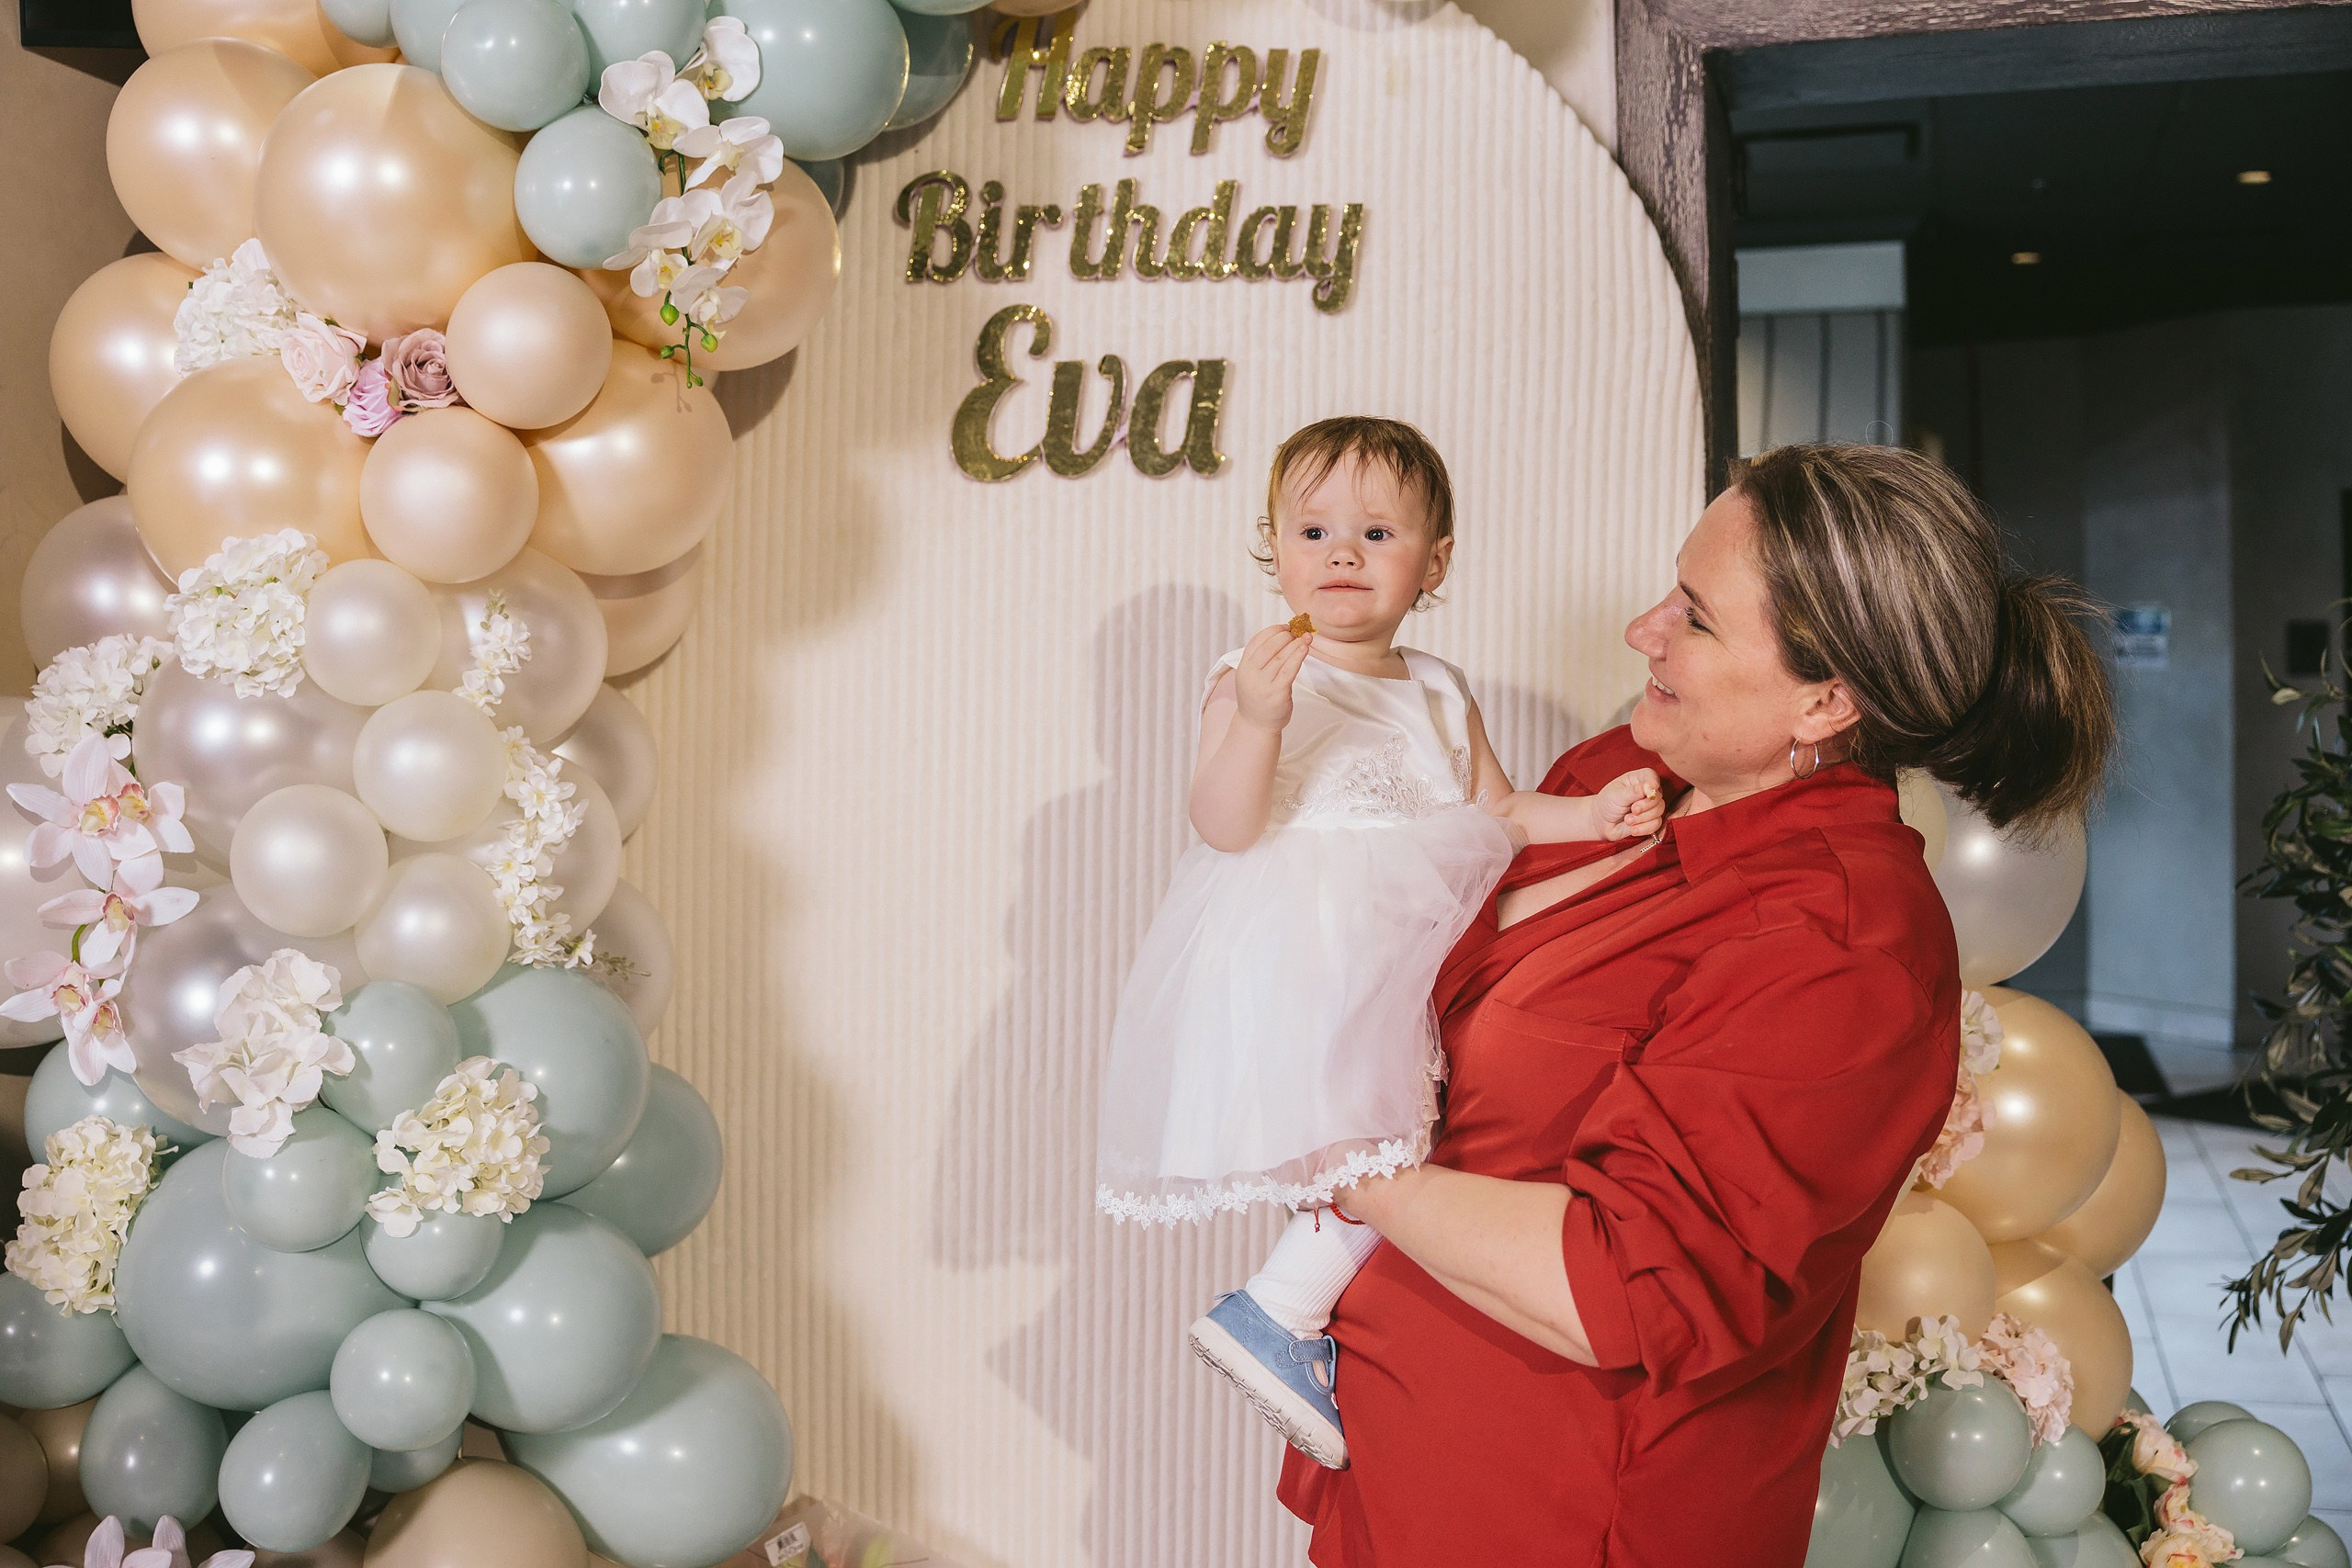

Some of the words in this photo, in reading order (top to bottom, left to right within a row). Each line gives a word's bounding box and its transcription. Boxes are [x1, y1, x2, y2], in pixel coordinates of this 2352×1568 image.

[989, 10, 1320, 157] Happy
[895, 170, 1363, 313] Birthday
[951, 304, 1227, 481] Eva
